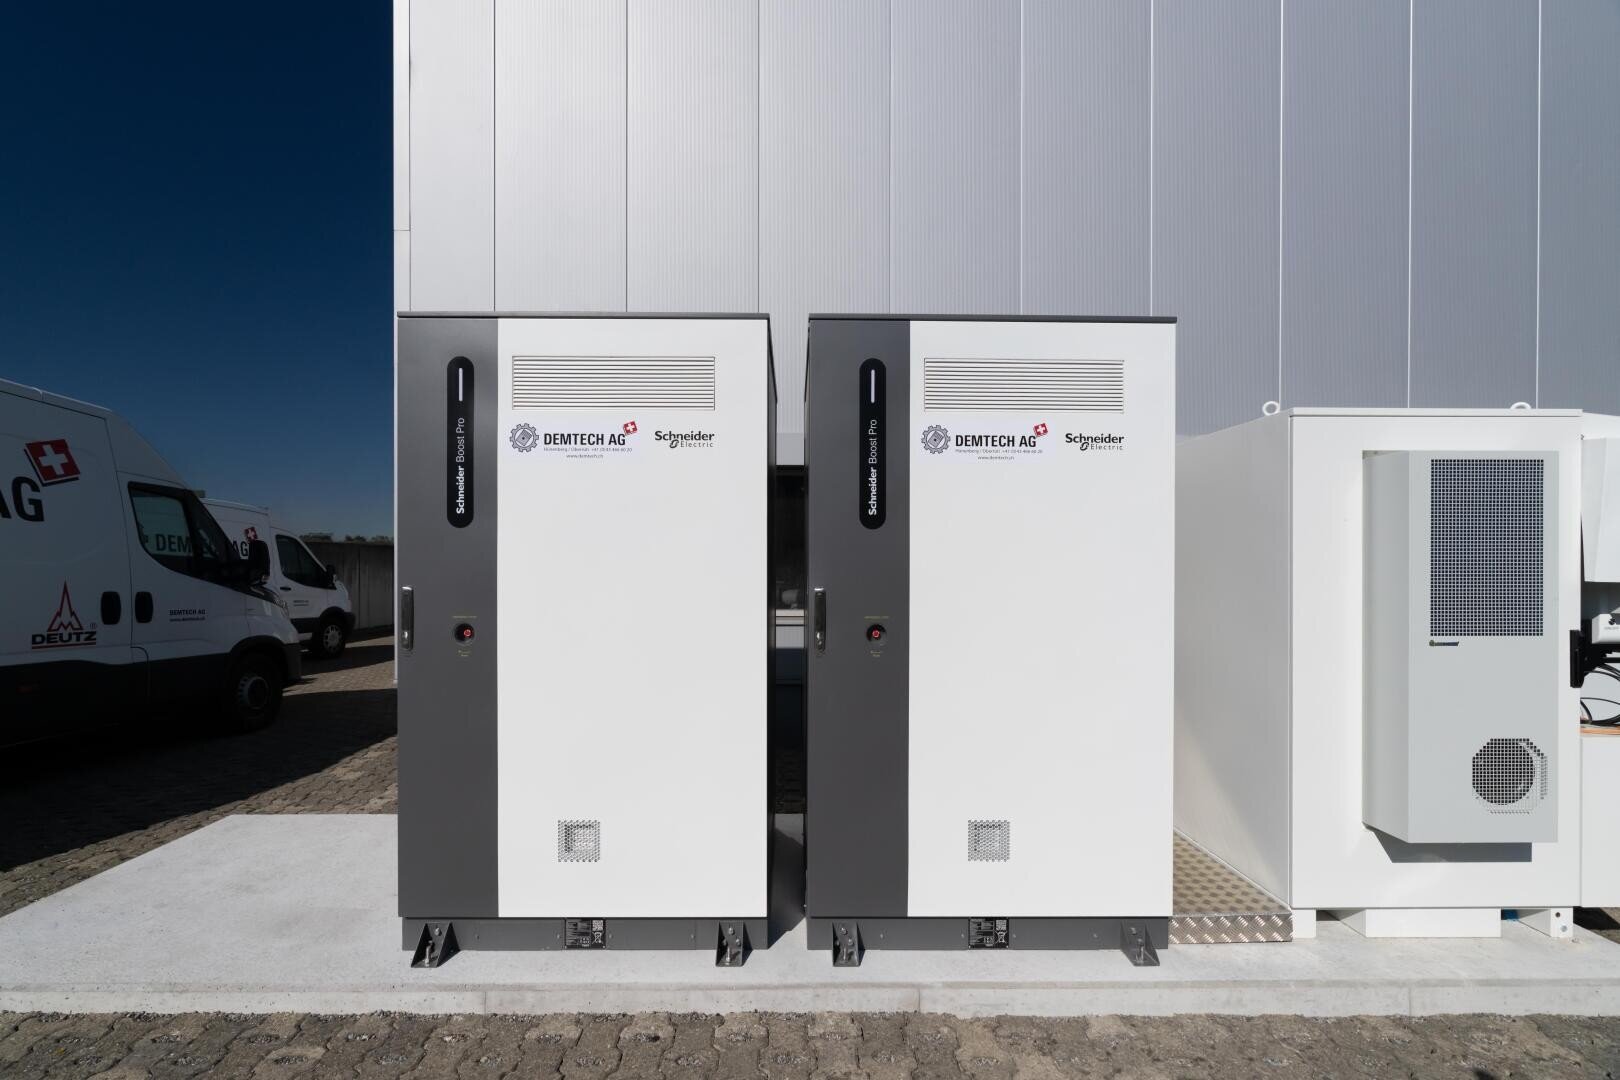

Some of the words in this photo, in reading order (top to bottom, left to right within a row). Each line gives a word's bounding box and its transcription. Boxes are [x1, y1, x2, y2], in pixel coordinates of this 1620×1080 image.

[455, 417, 465, 434] Pro
[868, 419, 878, 435] Pro
[543, 433, 604, 446] DEMTECH
[607, 433, 626, 446] AG
[654, 430, 715, 441] Schneider
[955, 434, 1015, 447] DEMTECH
[1018, 434, 1037, 447] AG
[1065, 432, 1125, 444] Schneider
[455, 436, 465, 463] Boost
[680, 440, 714, 448] Electric
[868, 438, 877, 464] Boost
[1090, 443, 1124, 451] Electric
[455, 465, 465, 514] Schneider
[868, 467, 877, 516] Schneider
[31, 630, 97, 645] DEUTZ
